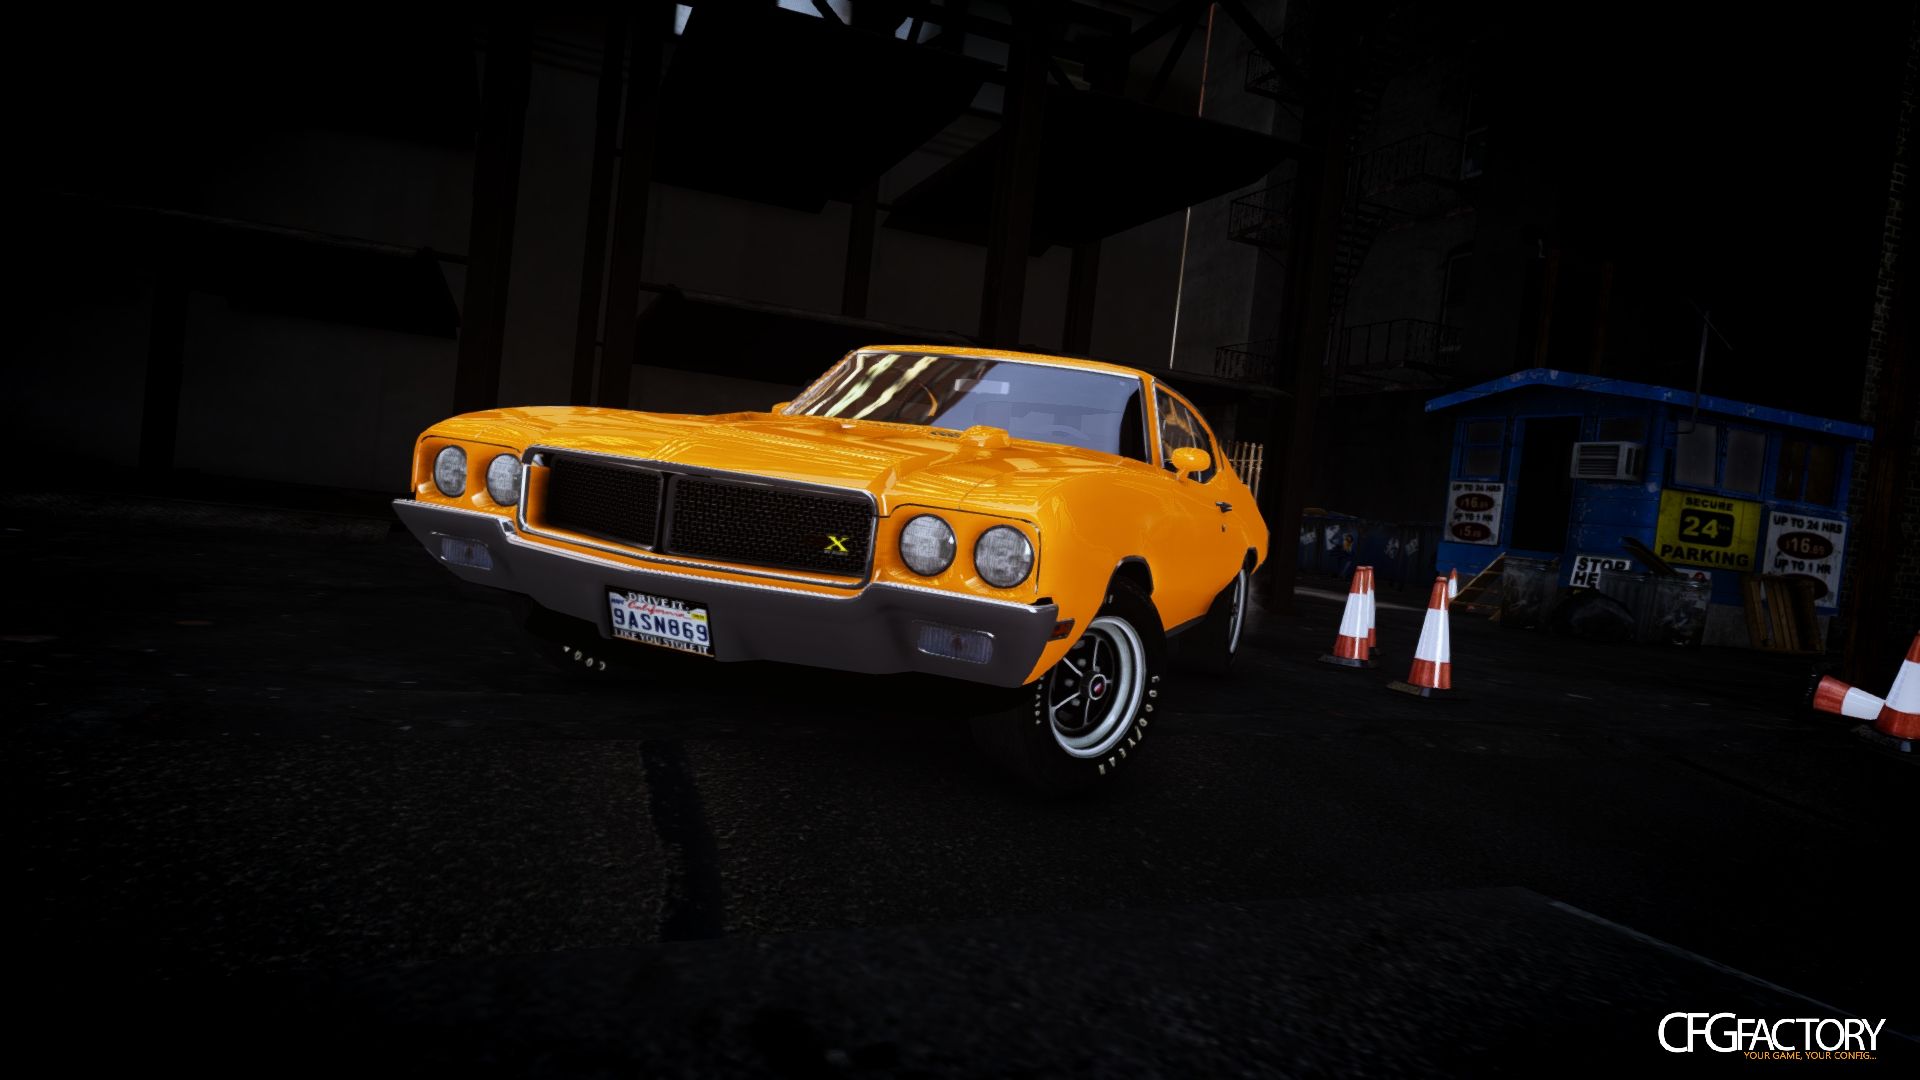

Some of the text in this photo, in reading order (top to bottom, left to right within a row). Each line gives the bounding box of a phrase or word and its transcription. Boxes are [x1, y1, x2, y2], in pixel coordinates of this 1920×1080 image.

[1685, 497, 1733, 510] SECURE
[1682, 516, 1719, 539] 24
[1774, 515, 1843, 533] UP TO 24 HRS
[824, 535, 849, 553] X
[1577, 557, 1627, 571] STOP
[1661, 545, 1749, 567] PARKING
[1774, 558, 1788, 571] UP
[1792, 561, 1805, 571] TO
[1817, 564, 1831, 574] HR
[627, 592, 670, 608] DRIVE
[613, 608, 709, 641] 9ASN869
[614, 628, 638, 639] LIKE
[640, 633, 663, 646] YOU
[663, 639, 697, 653] STOLE
